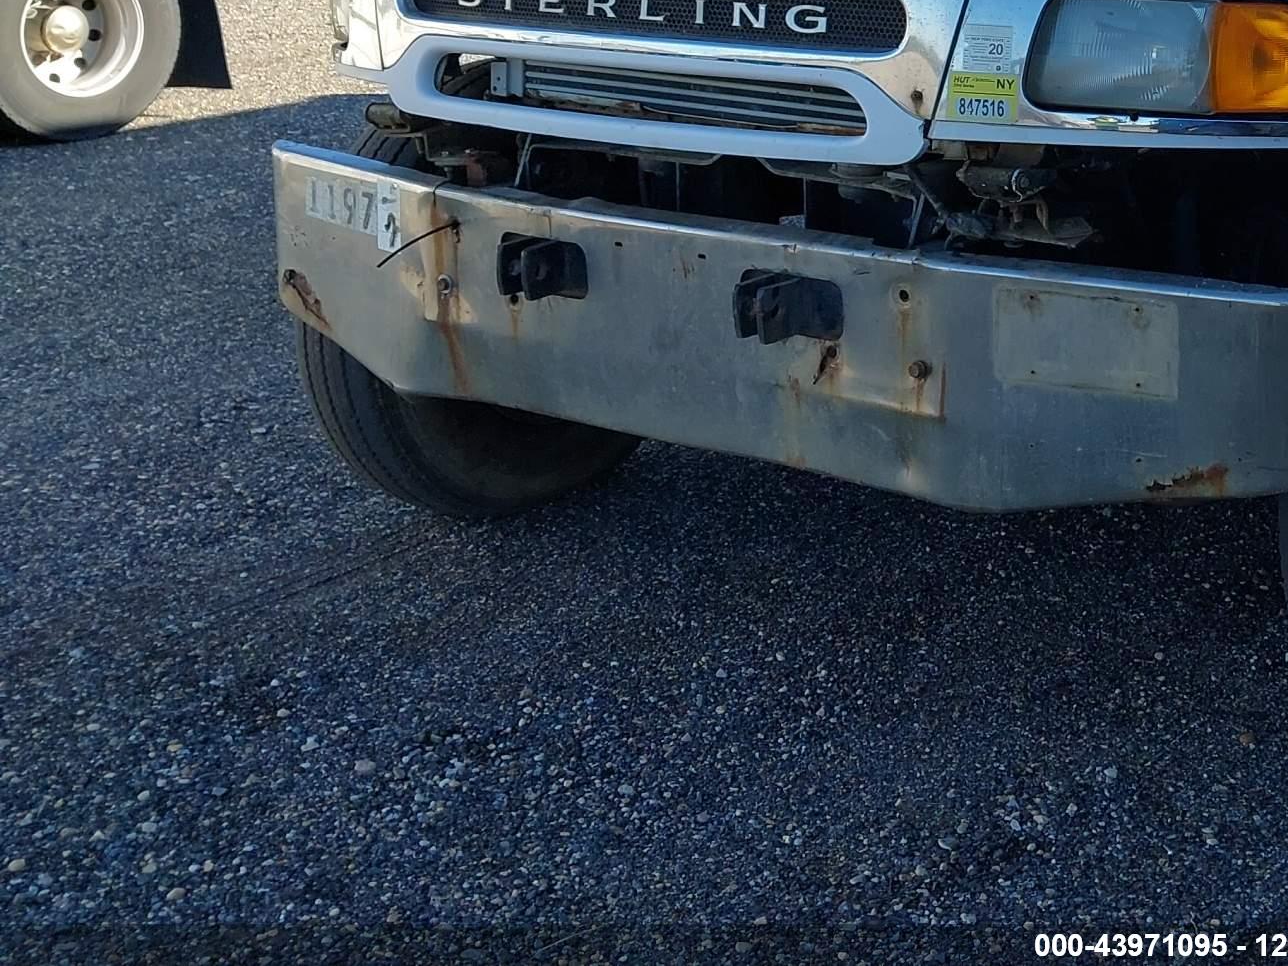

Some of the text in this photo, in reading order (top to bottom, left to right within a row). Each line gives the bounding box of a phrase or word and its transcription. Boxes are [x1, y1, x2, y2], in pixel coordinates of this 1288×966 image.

[988, 43, 1004, 56] 20
[953, 75, 972, 84] HUT
[996, 78, 1015, 90] NY
[958, 97, 1005, 118] 847516
